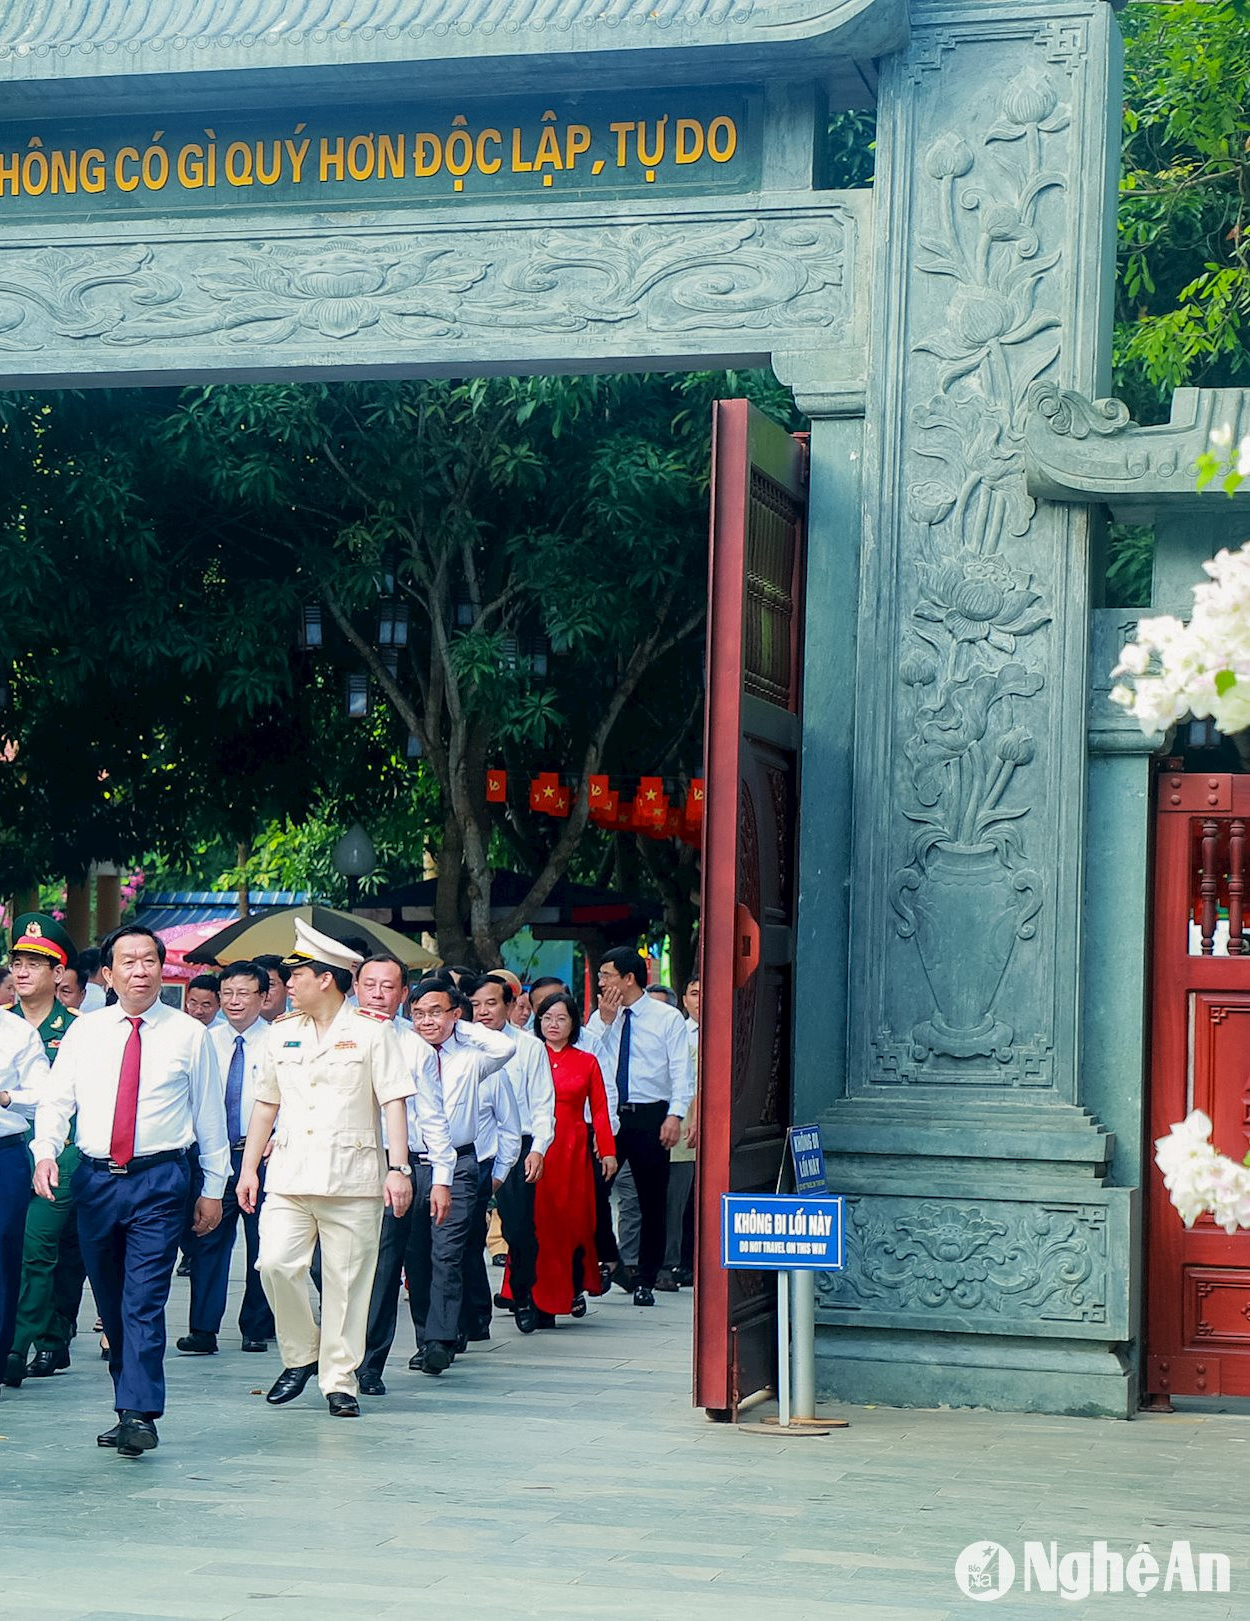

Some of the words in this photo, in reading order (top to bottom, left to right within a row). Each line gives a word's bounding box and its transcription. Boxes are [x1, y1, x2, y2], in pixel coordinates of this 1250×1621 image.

[114, 129, 170, 192] CÓ
[177, 127, 217, 191] GÌ
[224, 122, 309, 188] QUÝ
[319, 131, 407, 183] HƠN
[413, 114, 504, 192] ĐỘC
[610, 113, 668, 183] TỰ
[674, 116, 738, 165] DO
[734, 1208, 773, 1235] KHÔNG
[774, 1213, 787, 1236] ĐI
[788, 1207, 807, 1236] LỐI
[808, 1209, 832, 1237] NÀY
[749, 1240, 763, 1254] NOT
[763, 1241, 786, 1254] TRAVEL
[786, 1241, 796, 1255] ON
[797, 1242, 811, 1255] THIS
[811, 1242, 827, 1255] WAY
